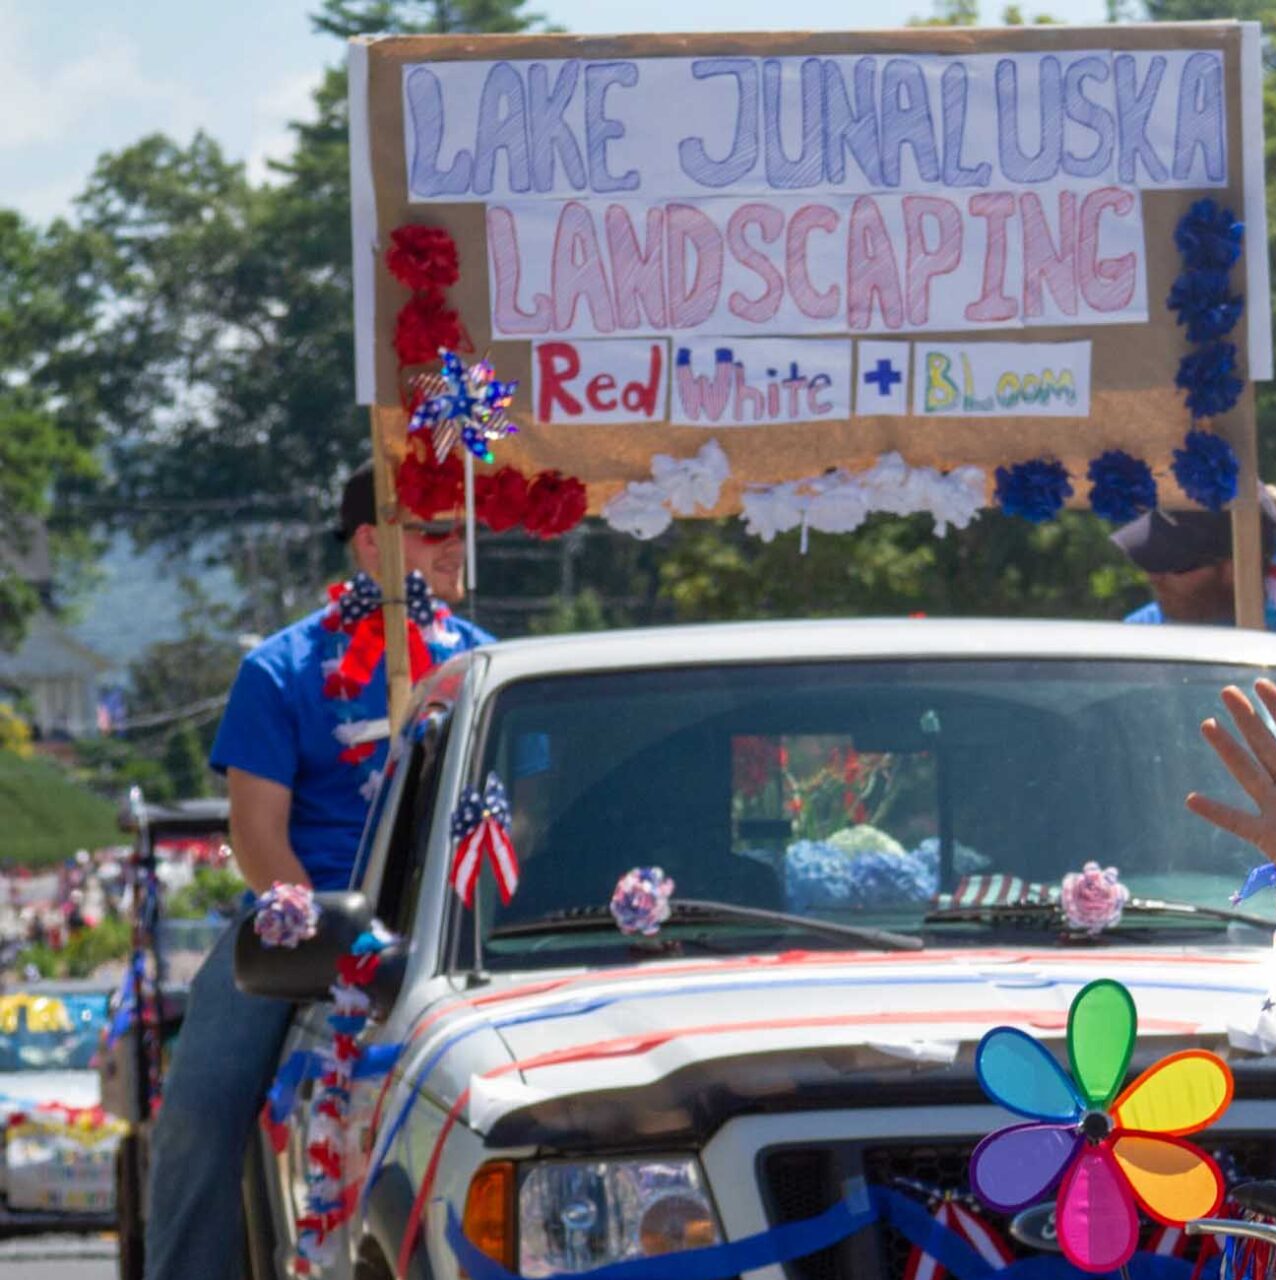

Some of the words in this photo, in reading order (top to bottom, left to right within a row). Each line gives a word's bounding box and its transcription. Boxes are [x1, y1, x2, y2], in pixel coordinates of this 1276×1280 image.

[407, 60, 640, 198] LAKE
[678, 52, 1226, 189] JUNALUSKA
[486, 187, 1137, 335] LANDSCAPING
[536, 342, 662, 423] Red
